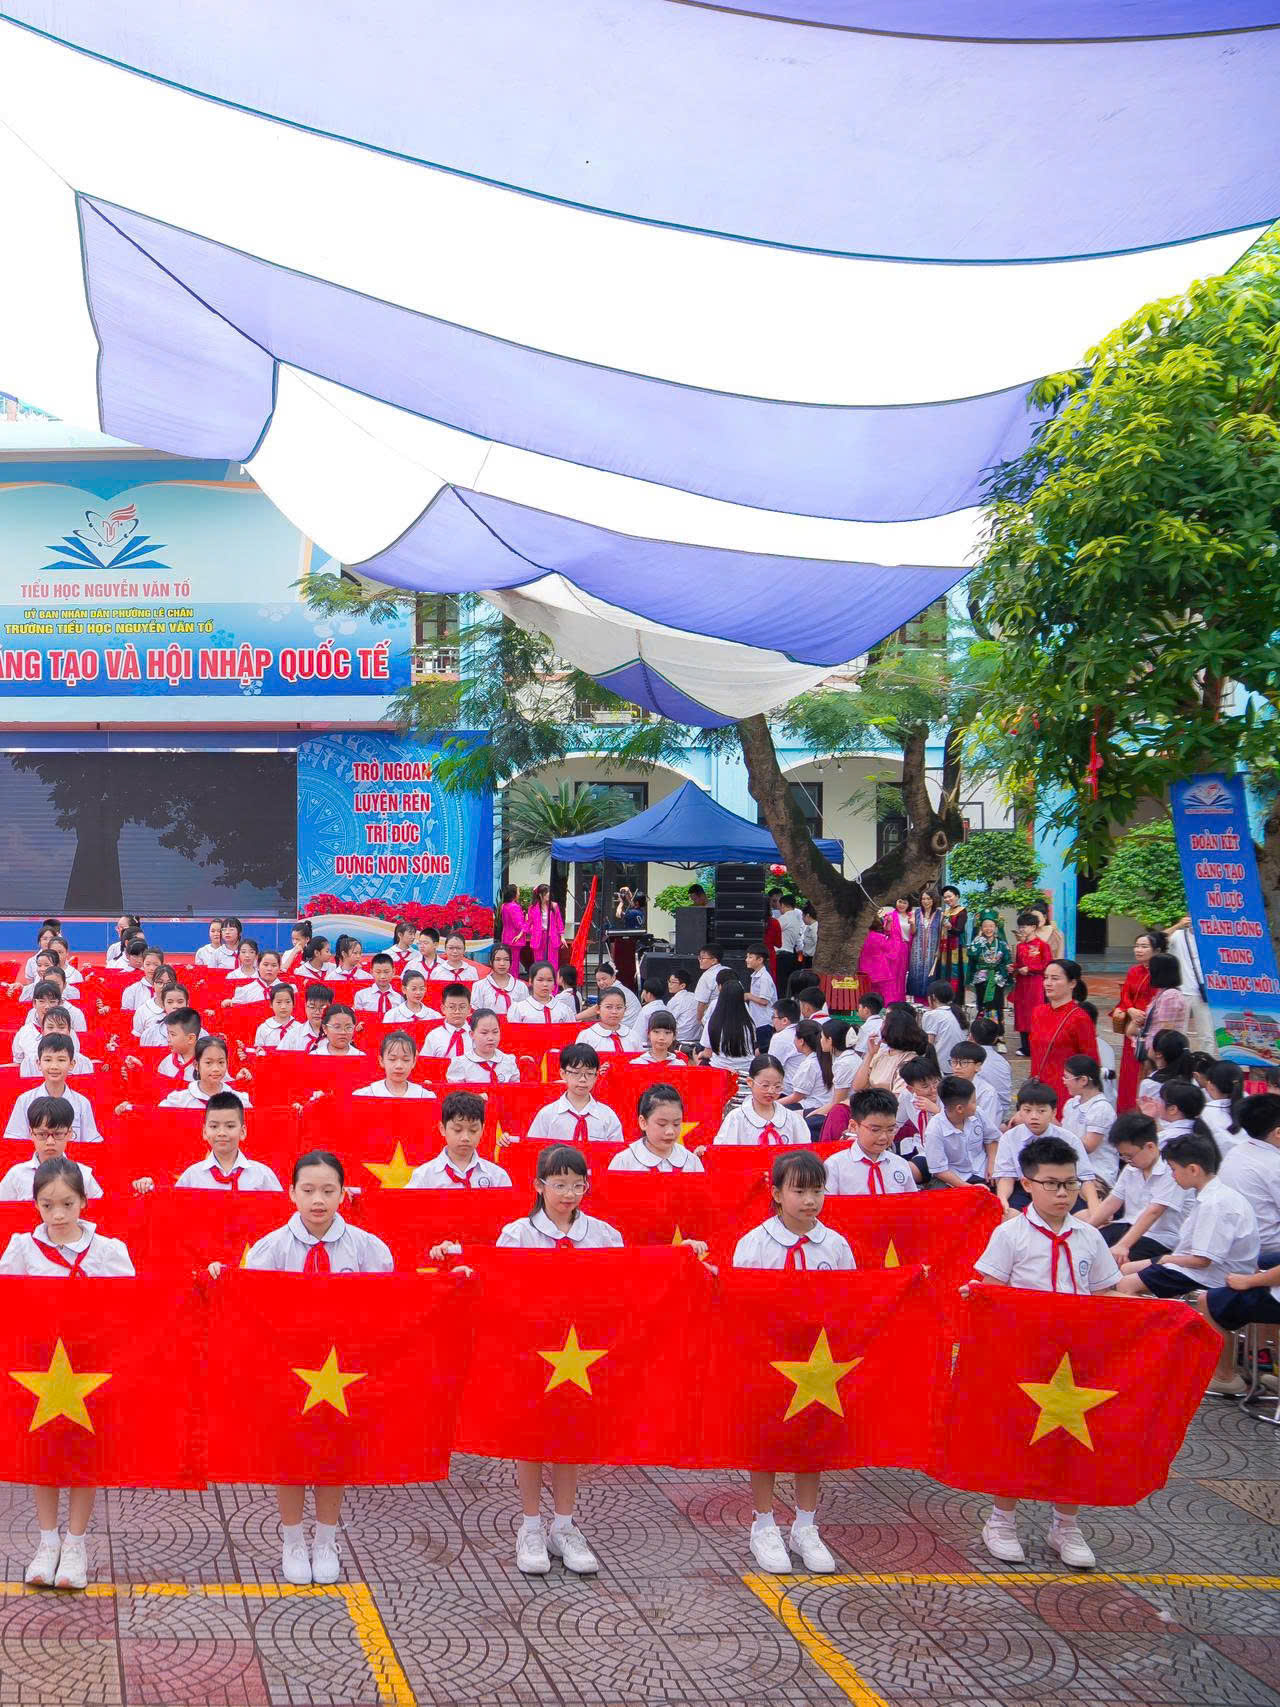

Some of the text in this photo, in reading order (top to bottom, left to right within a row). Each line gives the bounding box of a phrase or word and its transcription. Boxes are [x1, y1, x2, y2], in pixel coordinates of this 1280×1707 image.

[21, 577, 190, 600] TIỂU HỌC NGUYỄN VĂN TỐ
[39, 609, 59, 619] BAN
[61, 608, 88, 619] NHÂN
[90, 608, 110, 619] DÂN
[112, 608, 151, 618] PHƯỜNG
[153, 607, 165, 618] LÊ
[167, 607, 194, 618] CHÂN
[5, 618, 214, 636] TRƯỜNG TIỂU HỌC NGUYỄN VĂN TỐ
[48, 650, 98, 686] TẠO
[105, 643, 141, 679] VÀ
[146, 643, 192, 685] HỘI
[199, 642, 273, 685] NHẬP
[279, 639, 351, 682] QUỐC
[357, 639, 392, 679] TẾ
[353, 758, 432, 781] TRÒ NGOAN
[355, 790, 430, 816] LUYỆN RÈN
[366, 821, 419, 843] TRÍ ĐỨC
[1191, 827, 1240, 850] ĐOÀN KẾT
[335, 852, 450, 878] DỰNG NON SÔNG
[1196, 858, 1245, 884] SÁNG TẠO
[1199, 915, 1263, 938] THÀNH CÔNG
[1218, 948, 1254, 965] TRONG
[1205, 971, 1231, 990] NĂM
[1231, 976, 1252, 996] HỌC
[1253, 973, 1274, 993] MỚI
